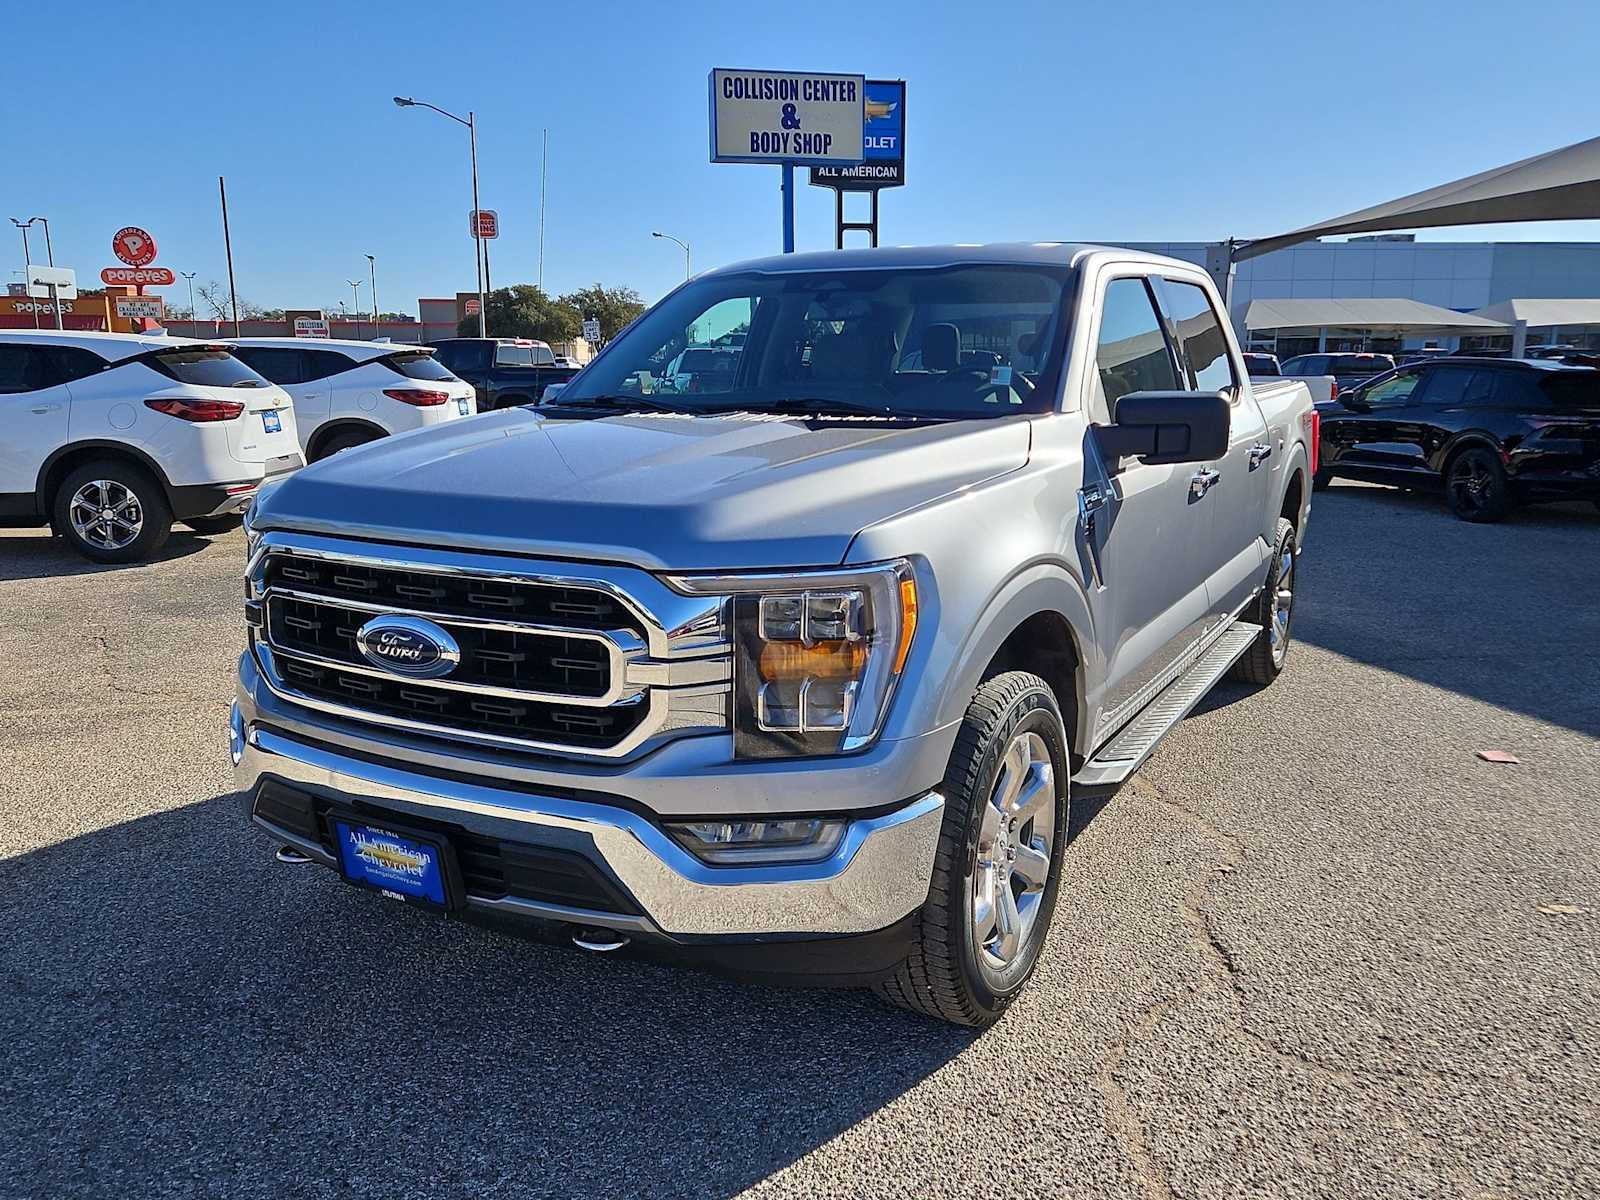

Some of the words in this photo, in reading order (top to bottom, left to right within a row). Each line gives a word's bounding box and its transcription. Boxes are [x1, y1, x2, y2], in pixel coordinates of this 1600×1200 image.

[723, 77, 799, 101] COLLISION
[803, 79, 857, 102] CENTER
[781, 103, 801, 130] &
[750, 132, 790, 154] BODY
[793, 133, 832, 155] SHOP
[818, 166, 839, 177] ALL
[841, 166, 898, 178] AMERICAN
[115, 228, 152, 244] LOUISIANA
[297, 321, 324, 329] COLLISION
[585, 332, 599, 340] 35
[376, 632, 423, 660] Ford
[350, 831, 366, 846] All
[369, 837, 431, 864] American
[361, 850, 424, 878] Chevrolet
